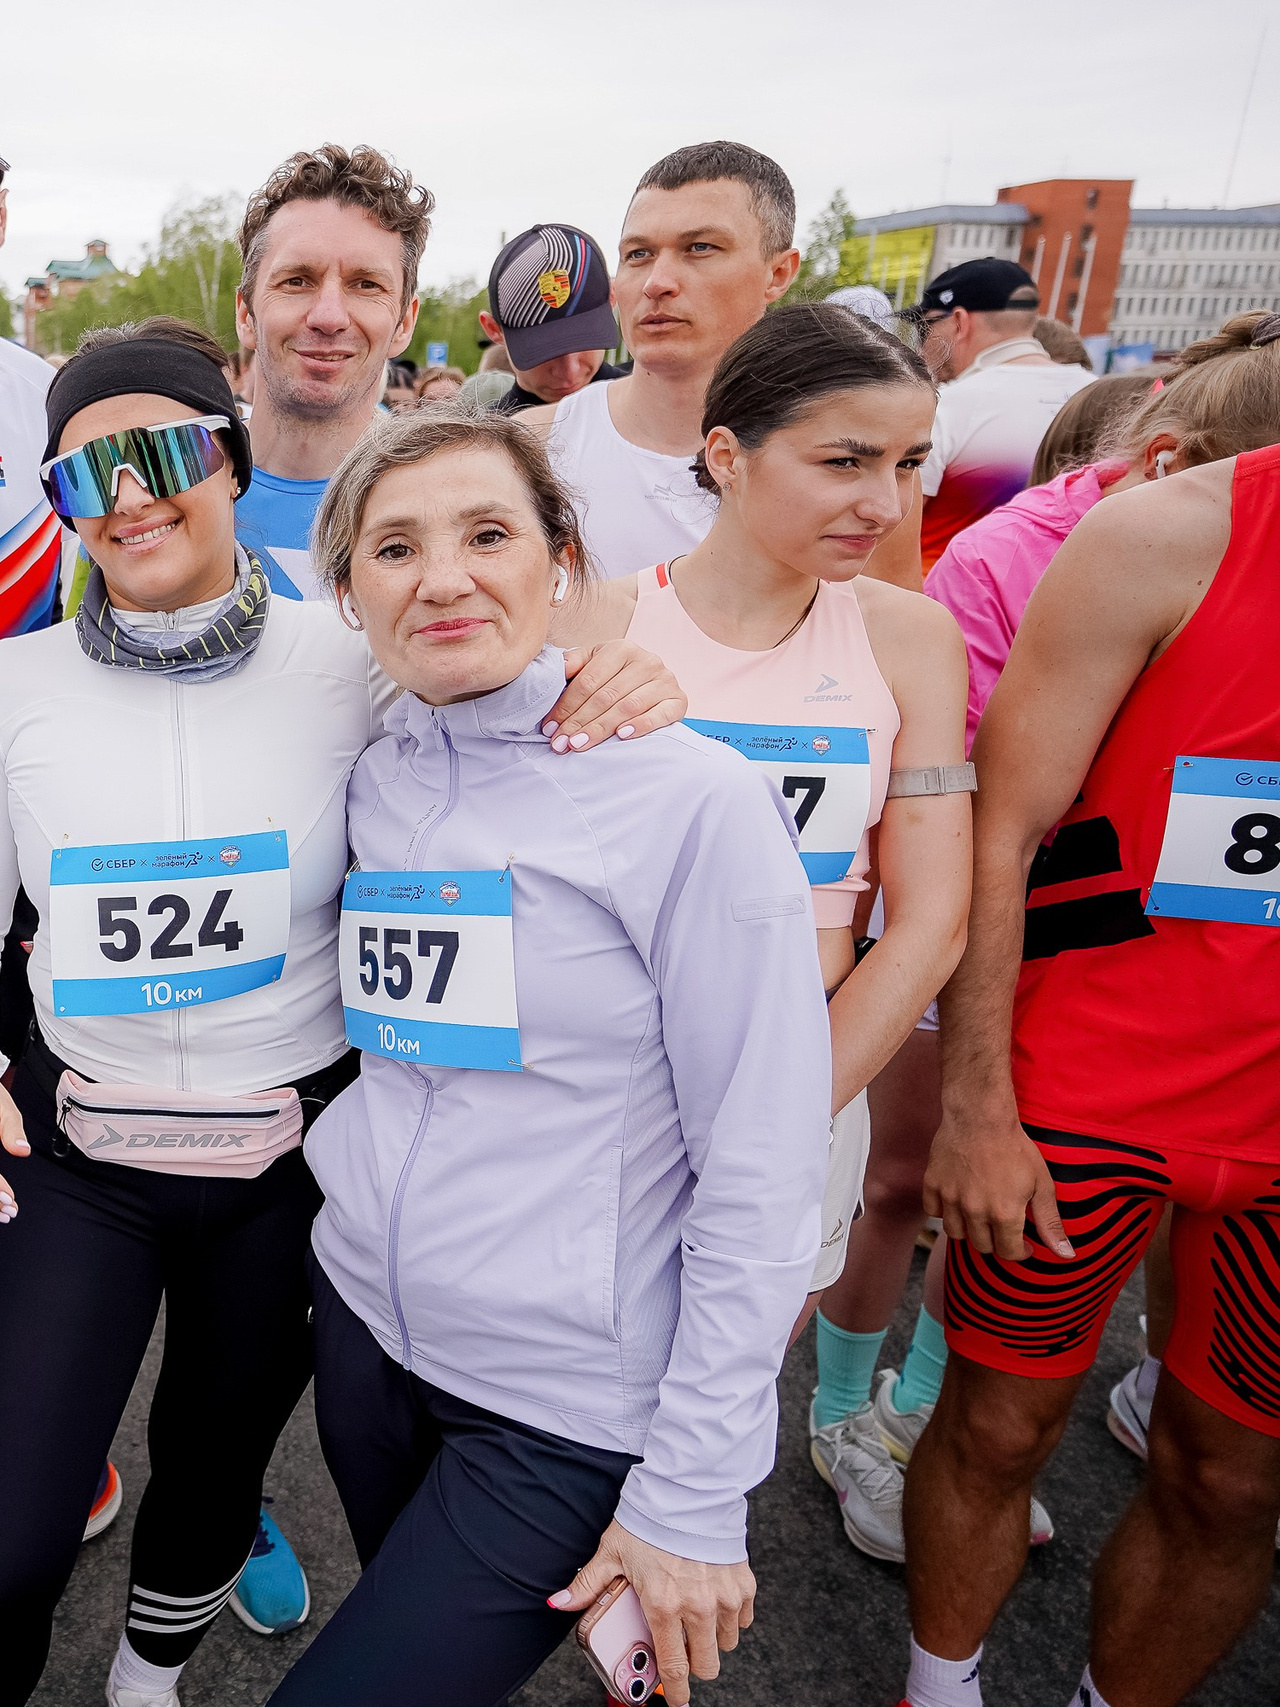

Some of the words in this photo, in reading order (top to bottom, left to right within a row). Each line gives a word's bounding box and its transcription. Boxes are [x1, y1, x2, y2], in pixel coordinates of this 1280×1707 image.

[803, 694, 853, 703] DEMIX
[746, 742, 780, 750] марафон
[1257, 776, 1280, 786] СБ
[782, 776, 827, 836] 7
[1223, 812, 1280, 876] 8
[106, 858, 136, 869] СБЕР
[151, 859, 185, 869] марафон
[363, 887, 379, 897] СБЕР
[97, 888, 244, 963] 524
[359, 926, 460, 1005] 557
[125, 1132, 253, 1148] DEMIX
